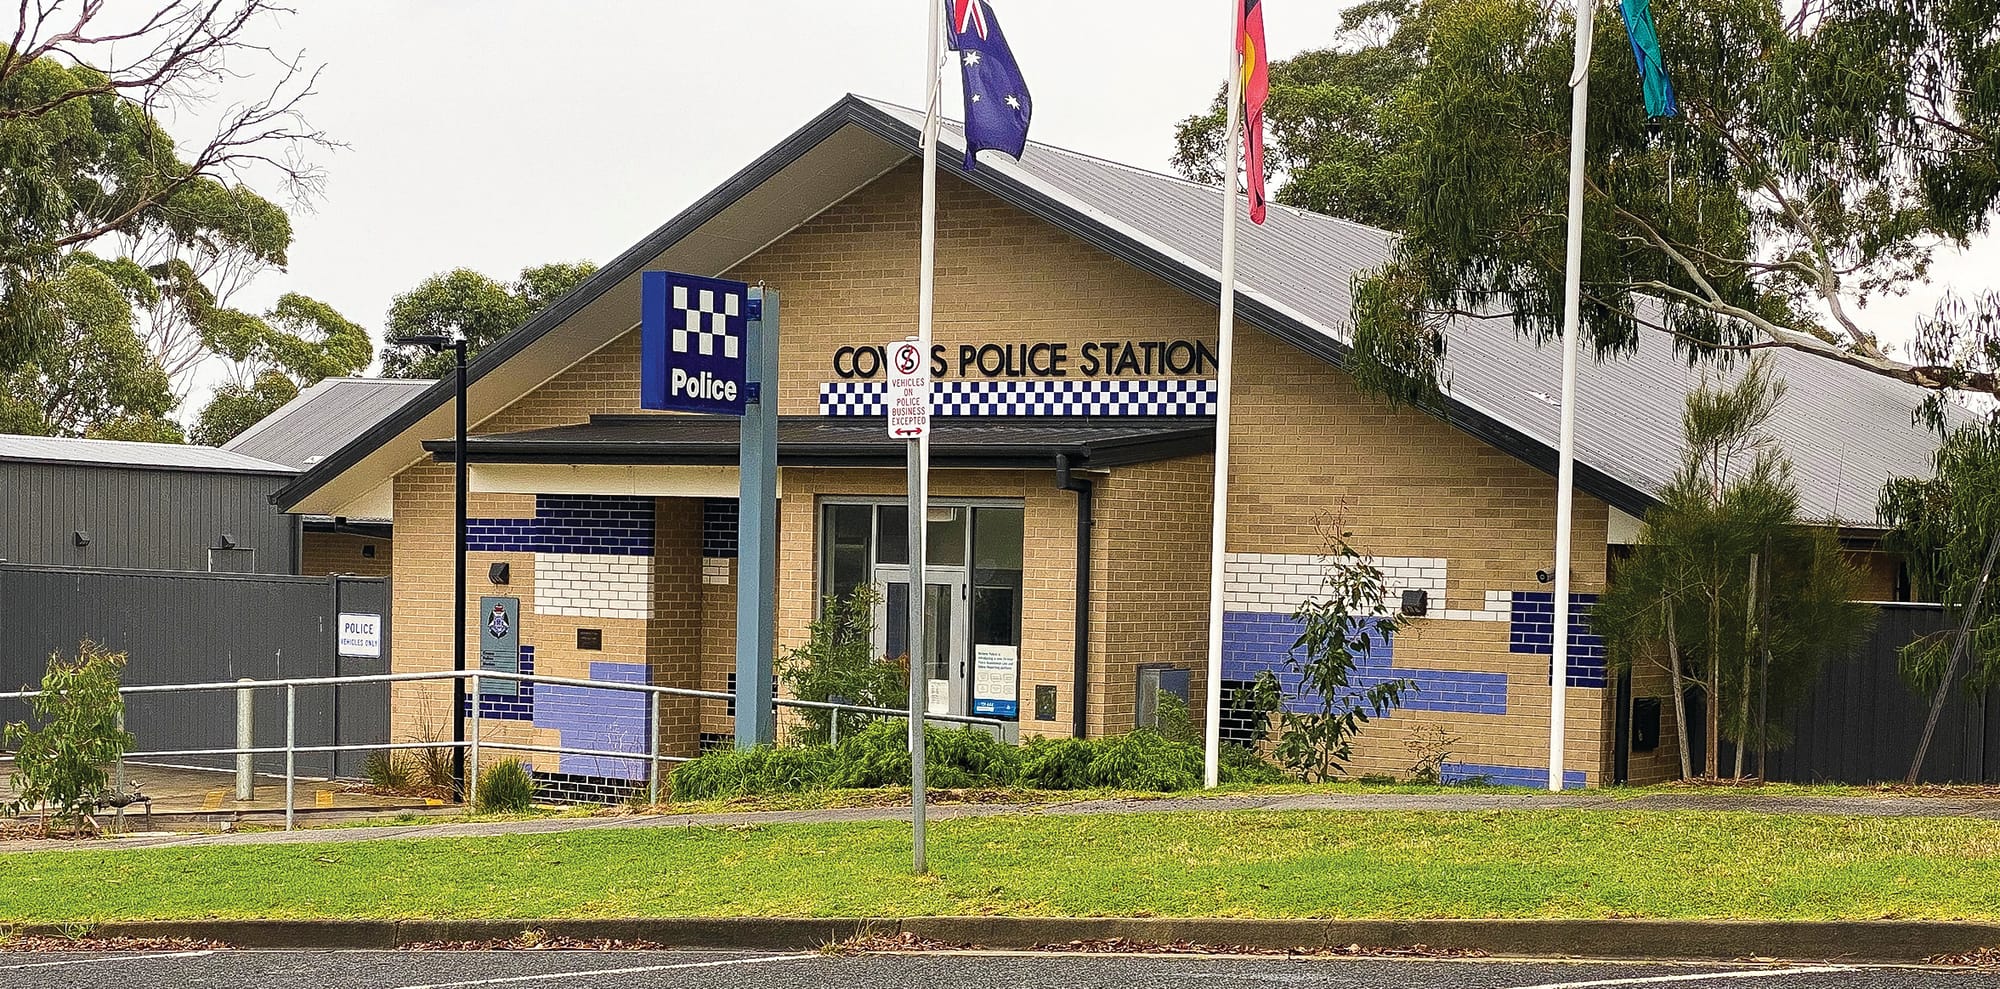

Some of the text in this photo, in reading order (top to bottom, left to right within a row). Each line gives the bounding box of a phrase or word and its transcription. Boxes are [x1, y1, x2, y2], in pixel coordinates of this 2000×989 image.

[833, 340, 1218, 379] COS POLICE STATION
[671, 368, 737, 401] Police
[892, 378, 925, 387] VEHICLES
[904, 388, 913, 396] ON
[896, 397, 920, 406] POLICE
[892, 407, 925, 416] BUSINESS
[892, 416, 926, 426] EXCEPTED
[345, 622, 374, 635] POLICE
